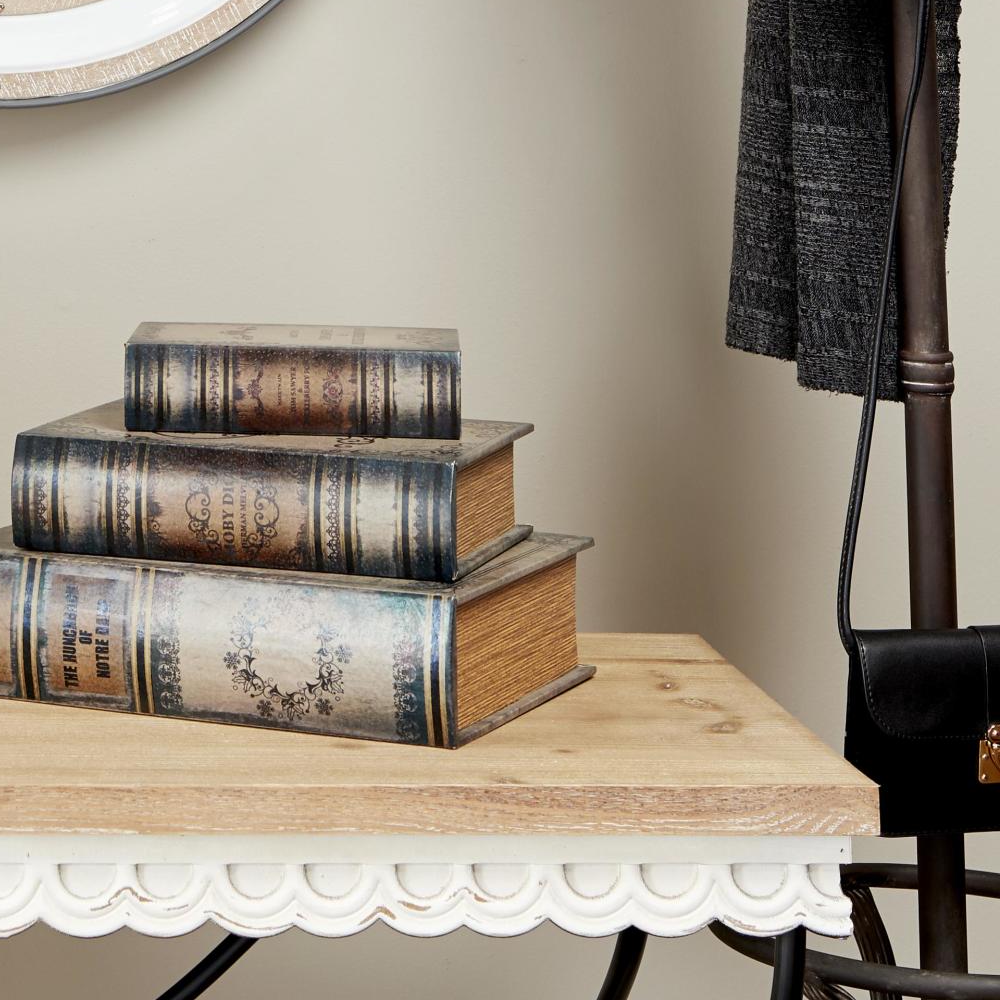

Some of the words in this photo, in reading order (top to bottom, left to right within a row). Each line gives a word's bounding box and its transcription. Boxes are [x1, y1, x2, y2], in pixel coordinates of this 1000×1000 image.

[79, 629, 93, 645] OF
[95, 638, 111, 679] NOTRE
[63, 665, 79, 688] THE
